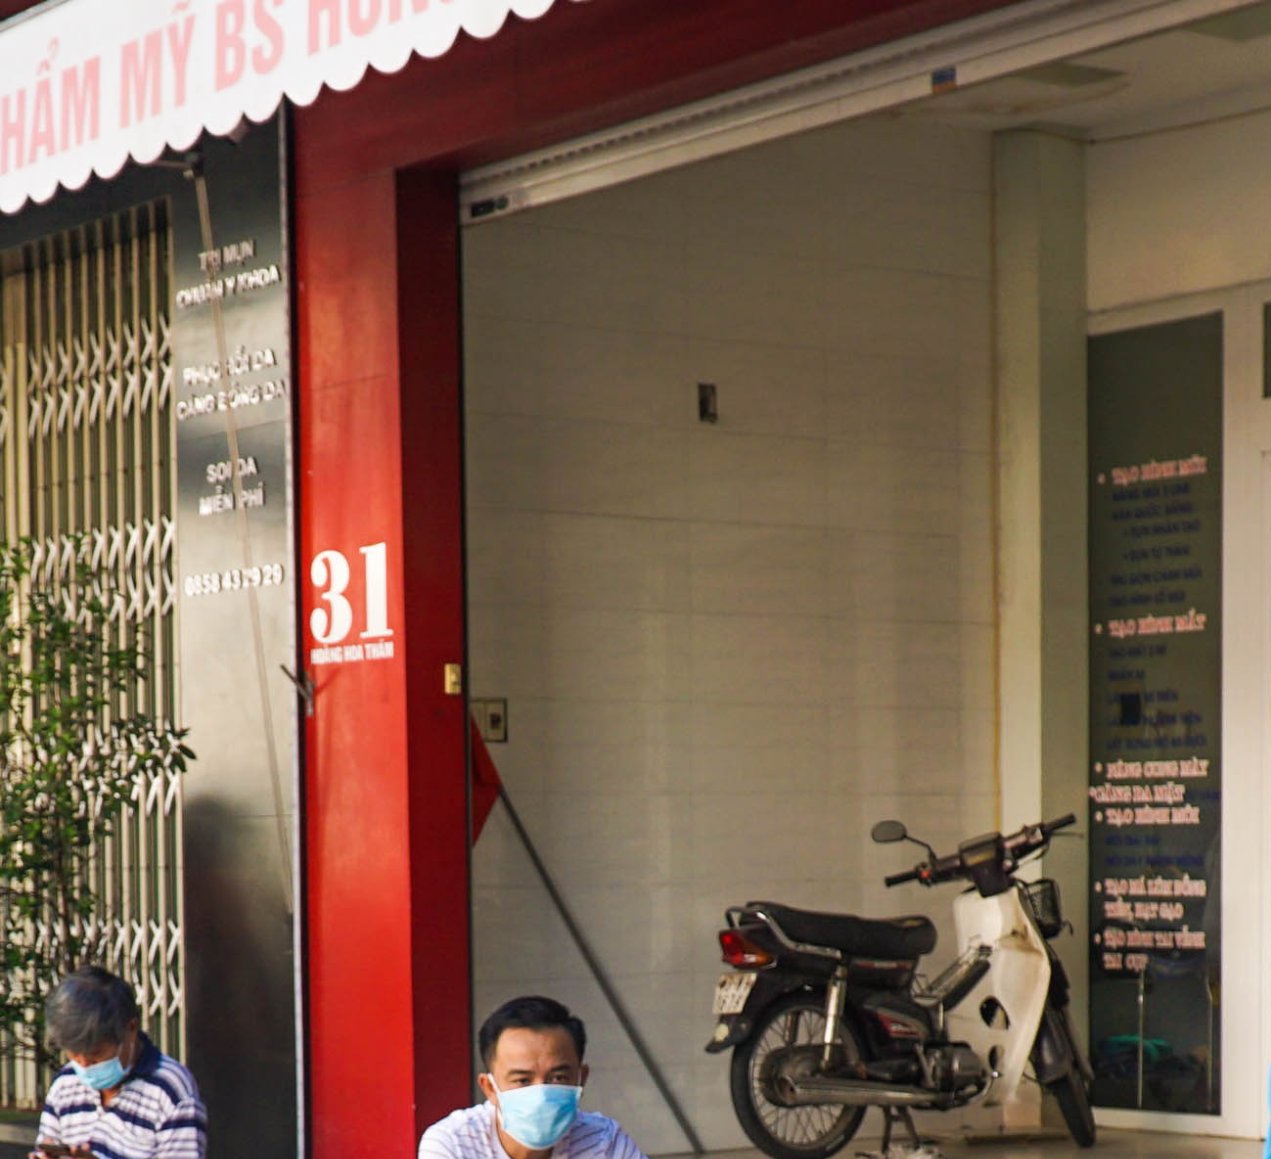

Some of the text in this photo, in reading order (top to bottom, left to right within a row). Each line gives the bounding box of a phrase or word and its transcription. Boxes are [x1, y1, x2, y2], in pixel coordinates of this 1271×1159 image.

[120, 2, 195, 128] MỸ
[214, 0, 284, 92] BS
[237, 263, 282, 292] KHOA
[310, 542, 394, 644] 31
[310, 638, 394, 665] HOÀNG HOA THÁM
